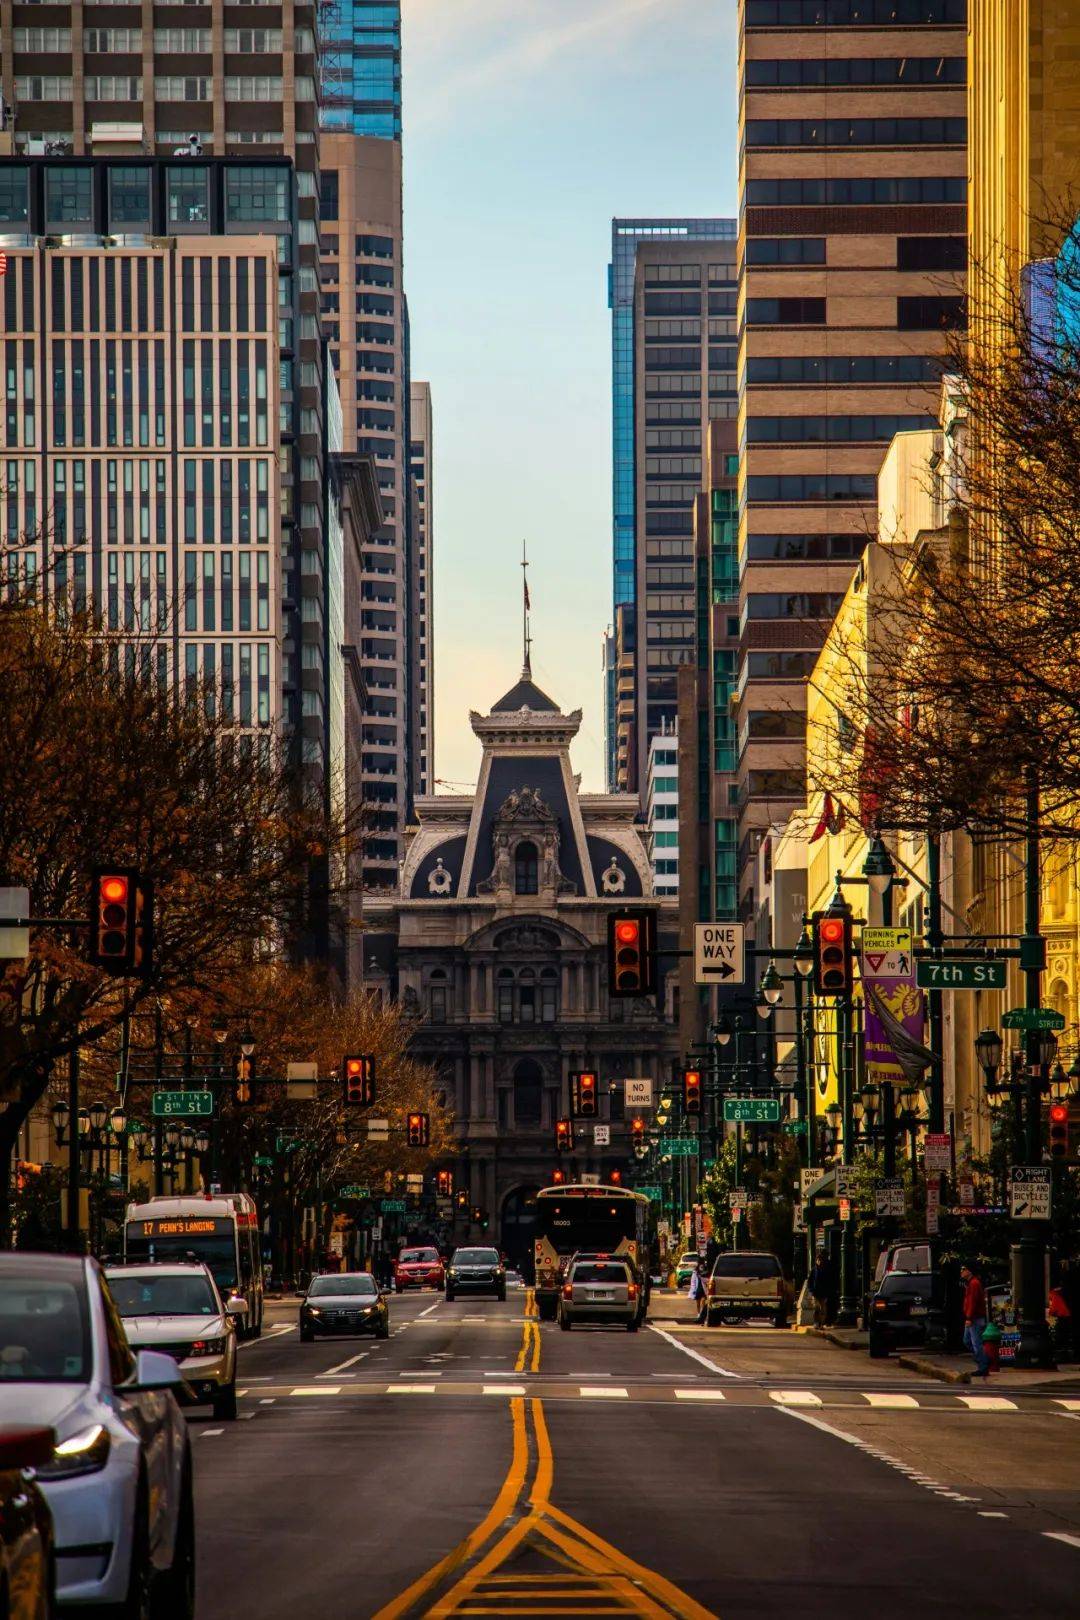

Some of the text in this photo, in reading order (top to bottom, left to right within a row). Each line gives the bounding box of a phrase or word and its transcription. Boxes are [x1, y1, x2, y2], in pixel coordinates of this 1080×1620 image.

[703, 929, 735, 943] ONE
[864, 930, 895, 938] TURNING
[864, 940, 895, 948] VEHICLES
[703, 945, 736, 958] WAY
[887, 961, 896, 969] TO
[929, 965, 996, 982] 7th St
[1039, 1020, 1064, 1028] STREET
[632, 1083, 644, 1092] NO
[164, 1102, 202, 1113] 8th St
[734, 1109, 769, 1119] 8th St
[804, 1170, 820, 1178] ONE
[1025, 1168, 1048, 1176] RIGHT
[1014, 1184, 1049, 1192] BUSES AND
[1014, 1192, 1049, 1201] BICYCLES
[1031, 1205, 1048, 1213] ONLY
[143, 1221, 216, 1235] 17 PENN'S LANDING
